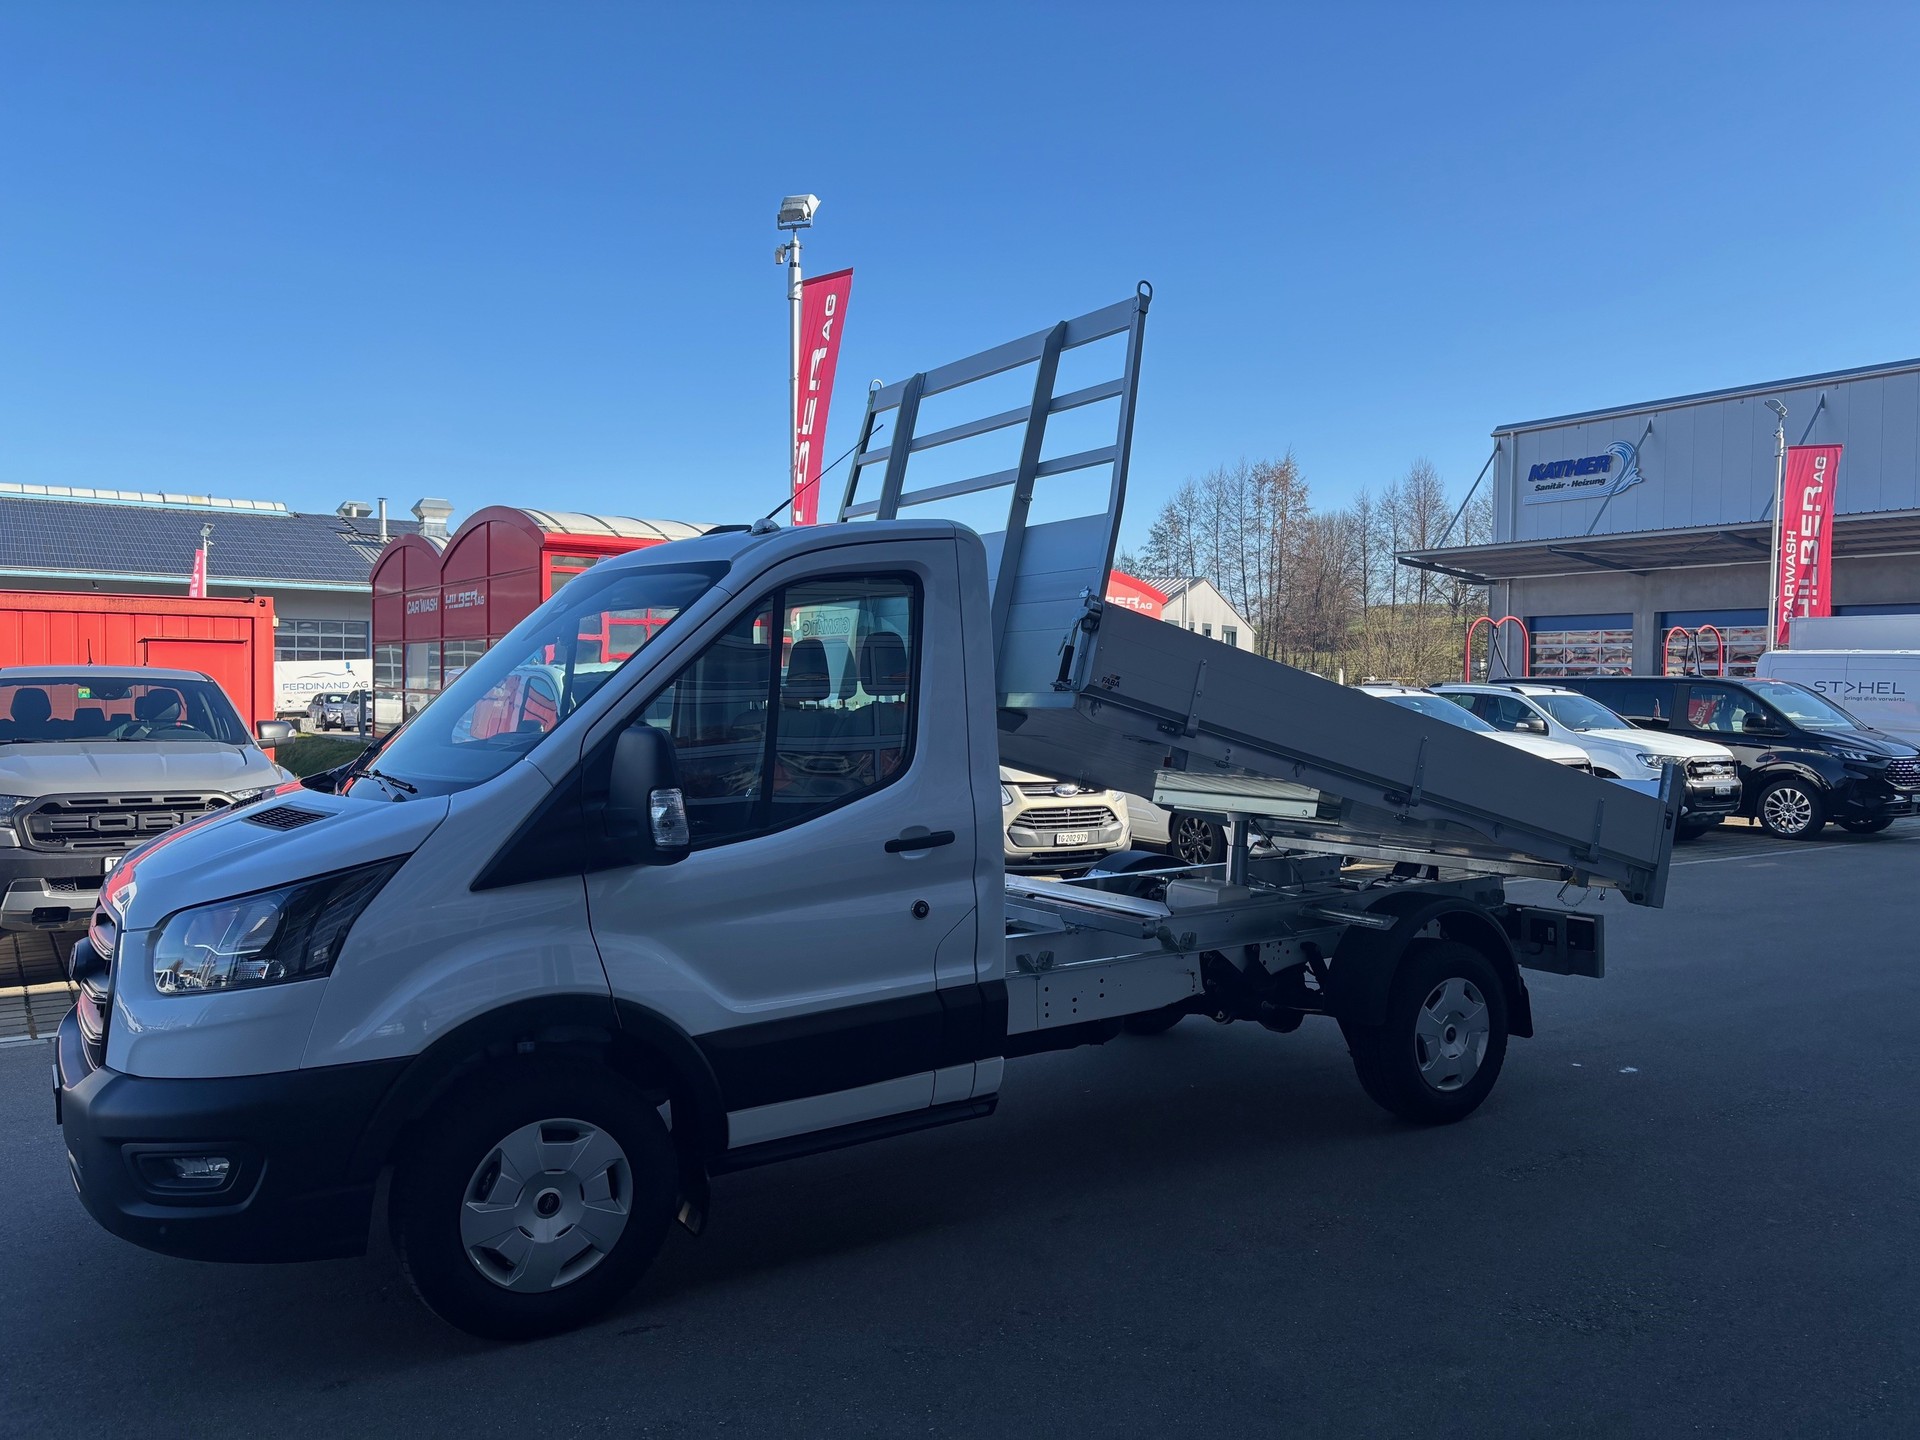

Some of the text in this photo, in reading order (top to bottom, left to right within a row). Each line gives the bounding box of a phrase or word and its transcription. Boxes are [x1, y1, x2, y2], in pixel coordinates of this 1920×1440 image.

[821, 294, 837, 341] AG
[1528, 455, 1612, 481] KATHER
[1813, 456, 1827, 484] AG
[1535, 481, 1565, 491] Sanitär
[1571, 478, 1606, 488] Heizung
[1783, 530, 1797, 623] CARWASH
[1140, 602, 1153, 610] AG
[282, 680, 369, 691] FERDINAND AG
[1101, 676, 1120, 688] FABA
